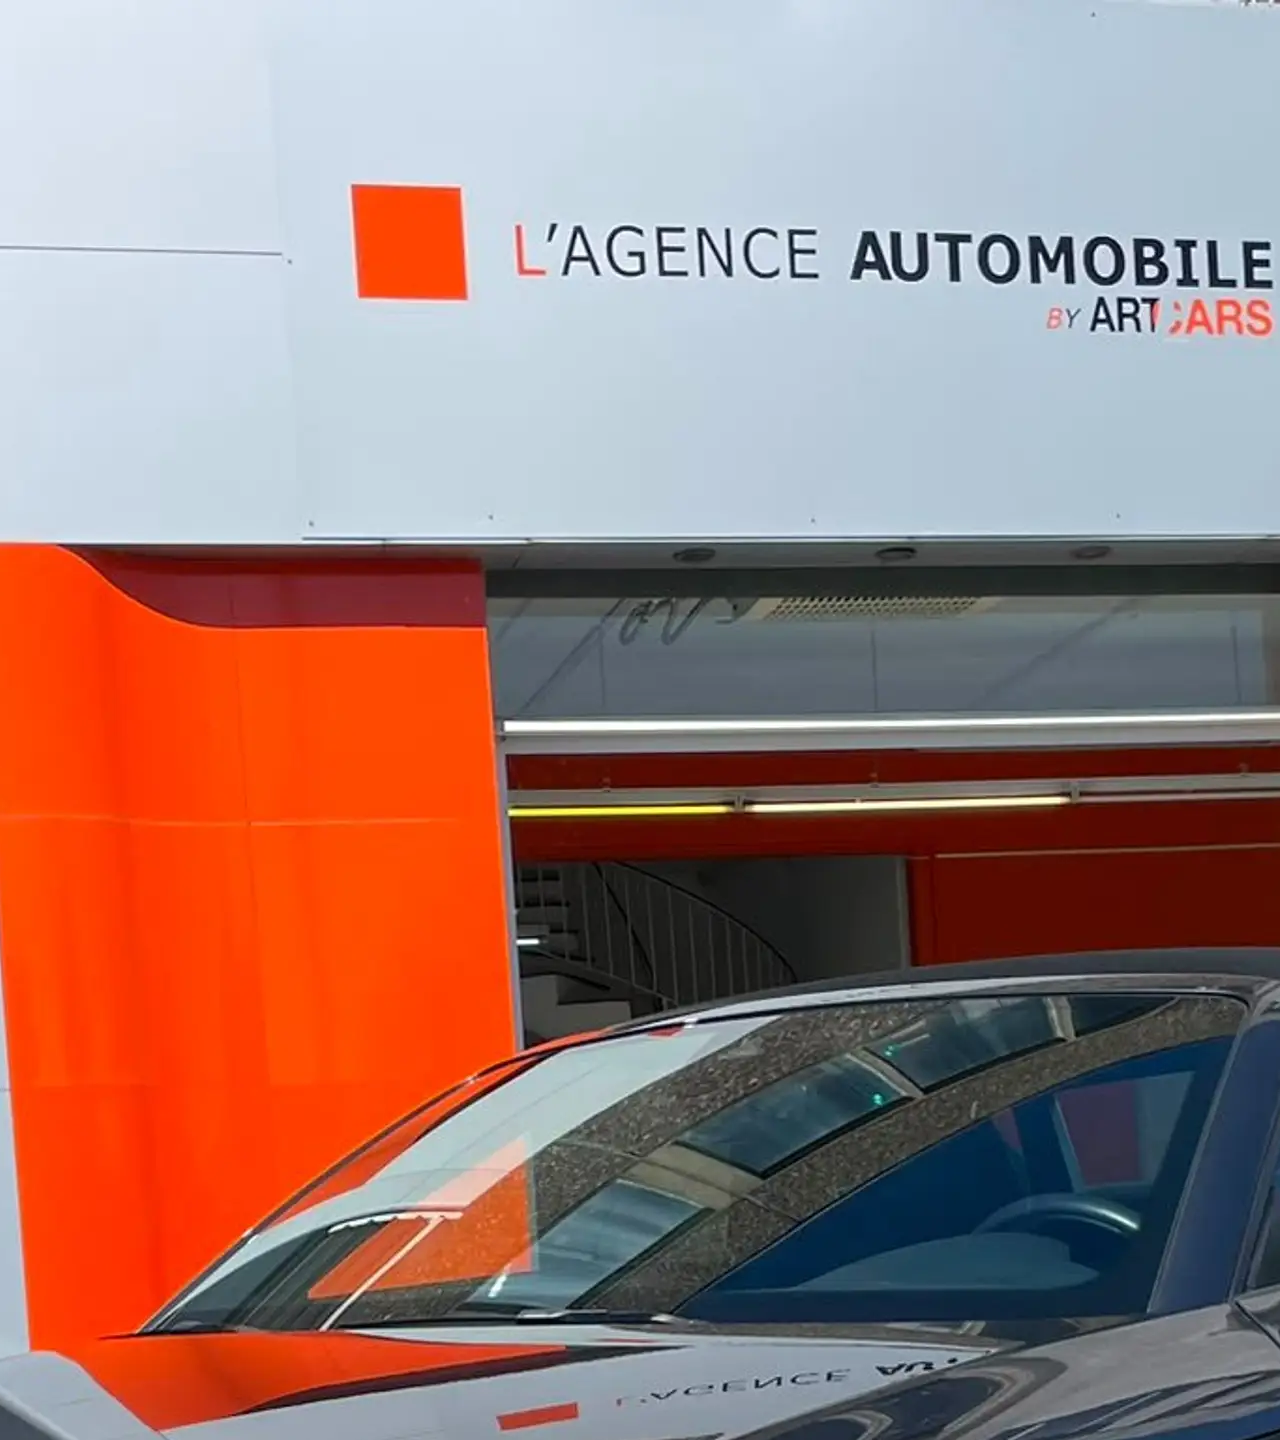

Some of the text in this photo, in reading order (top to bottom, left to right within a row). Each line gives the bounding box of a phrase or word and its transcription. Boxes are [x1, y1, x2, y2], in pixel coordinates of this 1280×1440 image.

[514, 223, 1274, 291] L'AGENCE AUTOMOBILE
[1046, 307, 1081, 330] BY
